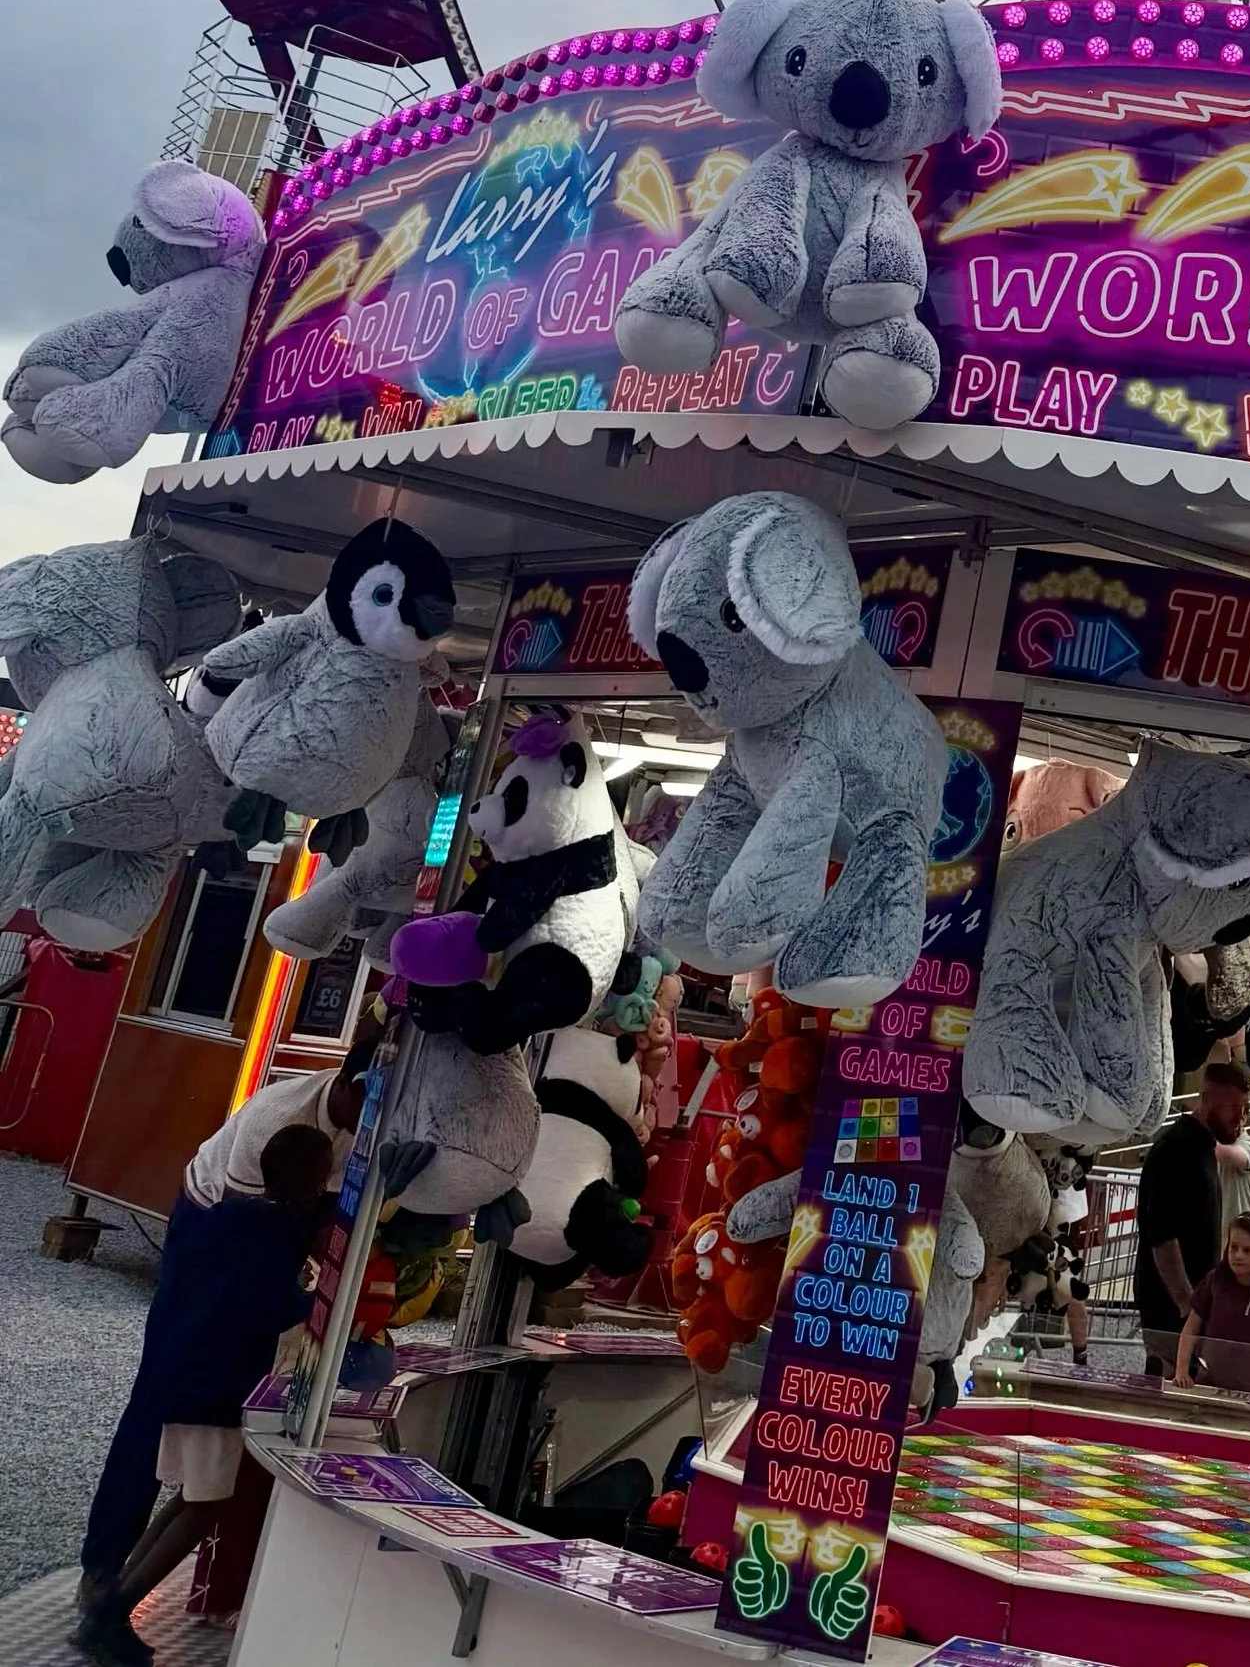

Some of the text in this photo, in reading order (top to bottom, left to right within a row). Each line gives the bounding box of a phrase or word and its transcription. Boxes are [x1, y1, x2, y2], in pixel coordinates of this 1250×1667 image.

[427, 120, 617, 263] Larry's
[265, 279, 457, 405] WORLD
[467, 287, 527, 350] OF
[611, 346, 759, 412] REPEAT
[950, 354, 1118, 435] PLAY
[881, 1002, 927, 1039] OF
[839, 1045, 951, 1093] GAMES
[822, 1170, 919, 1214] LAND 1
[830, 1207, 898, 1247] BALL
[823, 1243, 891, 1284] ON A
[795, 1276, 909, 1325] COLOUR
[793, 1311, 900, 1361] TO WIN
[779, 1365, 891, 1421] EVERY
[756, 1411, 895, 1473] COLOUR
[767, 1461, 870, 1519] WINS!
